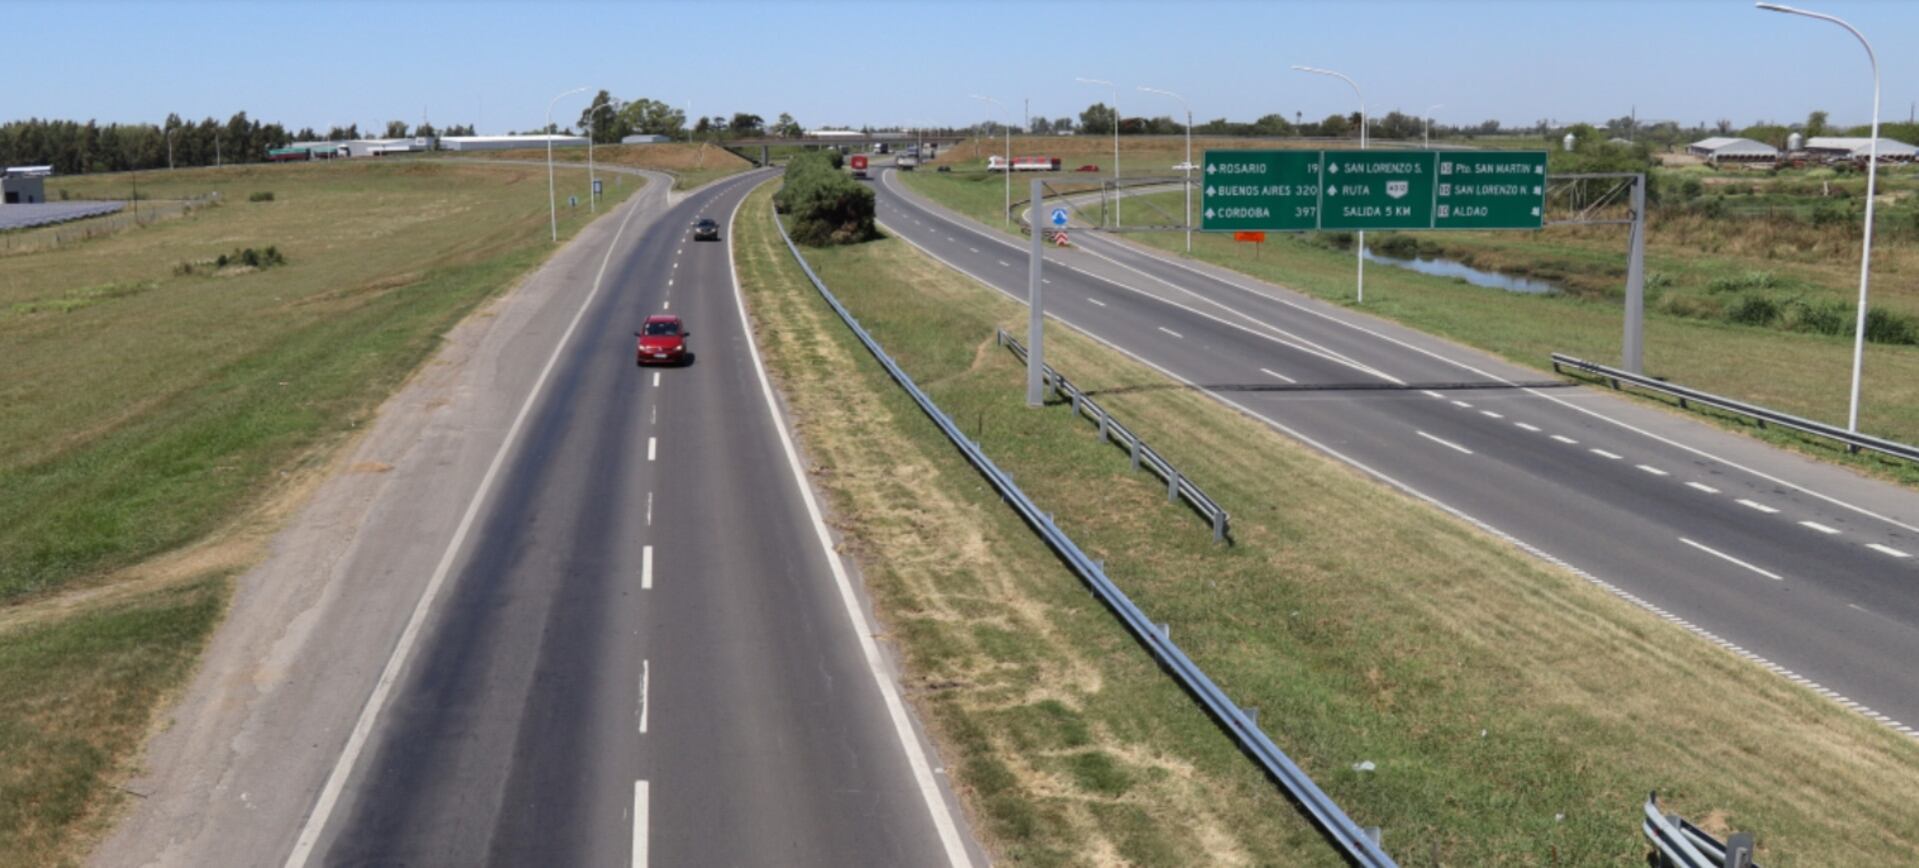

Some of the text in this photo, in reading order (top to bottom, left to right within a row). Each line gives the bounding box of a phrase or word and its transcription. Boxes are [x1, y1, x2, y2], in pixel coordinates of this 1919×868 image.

[1219, 163, 1319, 174] ROSARIO 19
[1344, 163, 1364, 174] SAN
[1366, 163, 1413, 174] LORENZO
[1475, 163, 1494, 174] SAN
[1218, 185, 1318, 196] BUENOS AIRES 320
[1342, 185, 1370, 196] RUTA
[1454, 185, 1474, 196] SAN
[1476, 185, 1518, 196] LORENZO
[1217, 206, 1317, 218] CORDOBA 397
[1343, 206, 1411, 217] SALIDA 5 KM
[1453, 206, 1488, 217] ALDAO
